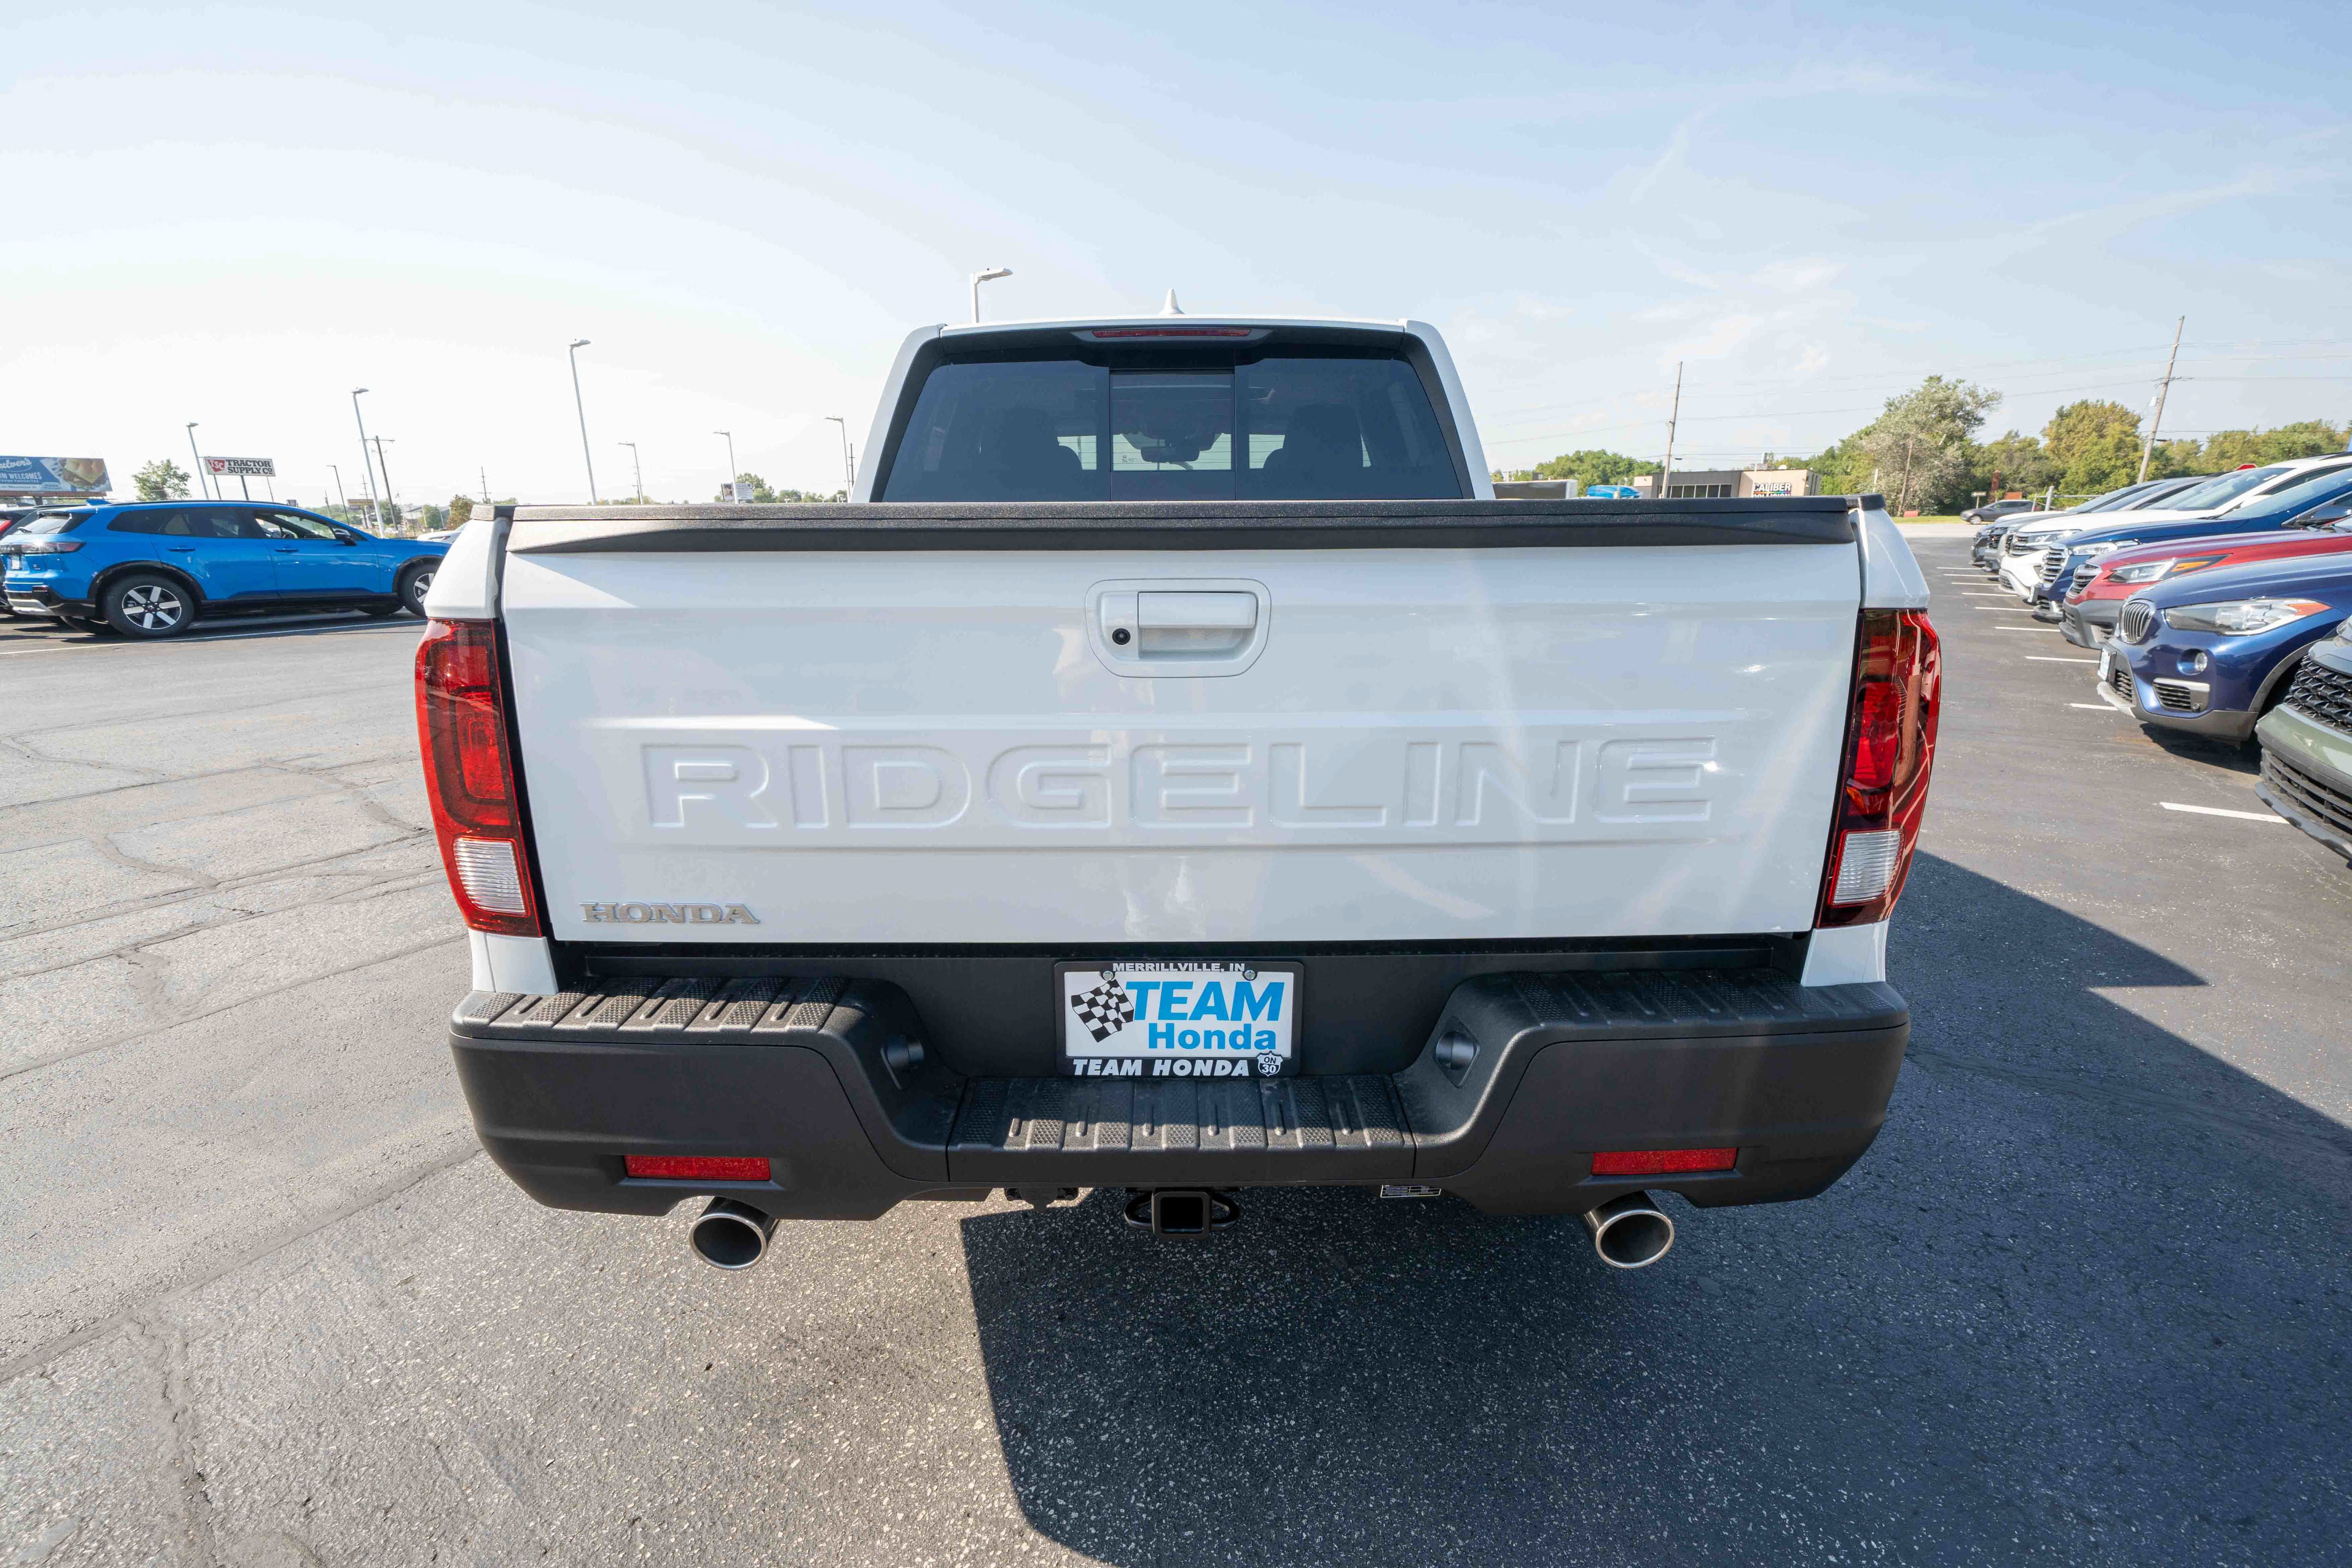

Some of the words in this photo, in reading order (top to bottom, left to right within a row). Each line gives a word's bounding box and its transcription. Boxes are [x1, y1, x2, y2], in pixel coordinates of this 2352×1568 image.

[0, 458, 32, 468] ulver's
[209, 460, 224, 470] TSC
[1754, 483, 1791, 491] CALIBER
[641, 735, 1716, 829] RIDGELINE
[579, 902, 760, 924] HONDA
[1113, 963, 1224, 972] MERRILLVILLE,
[1229, 963, 1245, 972] IN
[1125, 981, 1285, 1021] TEAM
[1149, 1023, 1276, 1049] Honda
[1073, 1059, 1142, 1076] TEAM
[1152, 1059, 1249, 1076] HONDA
[1262, 1064, 1276, 1073] 30
